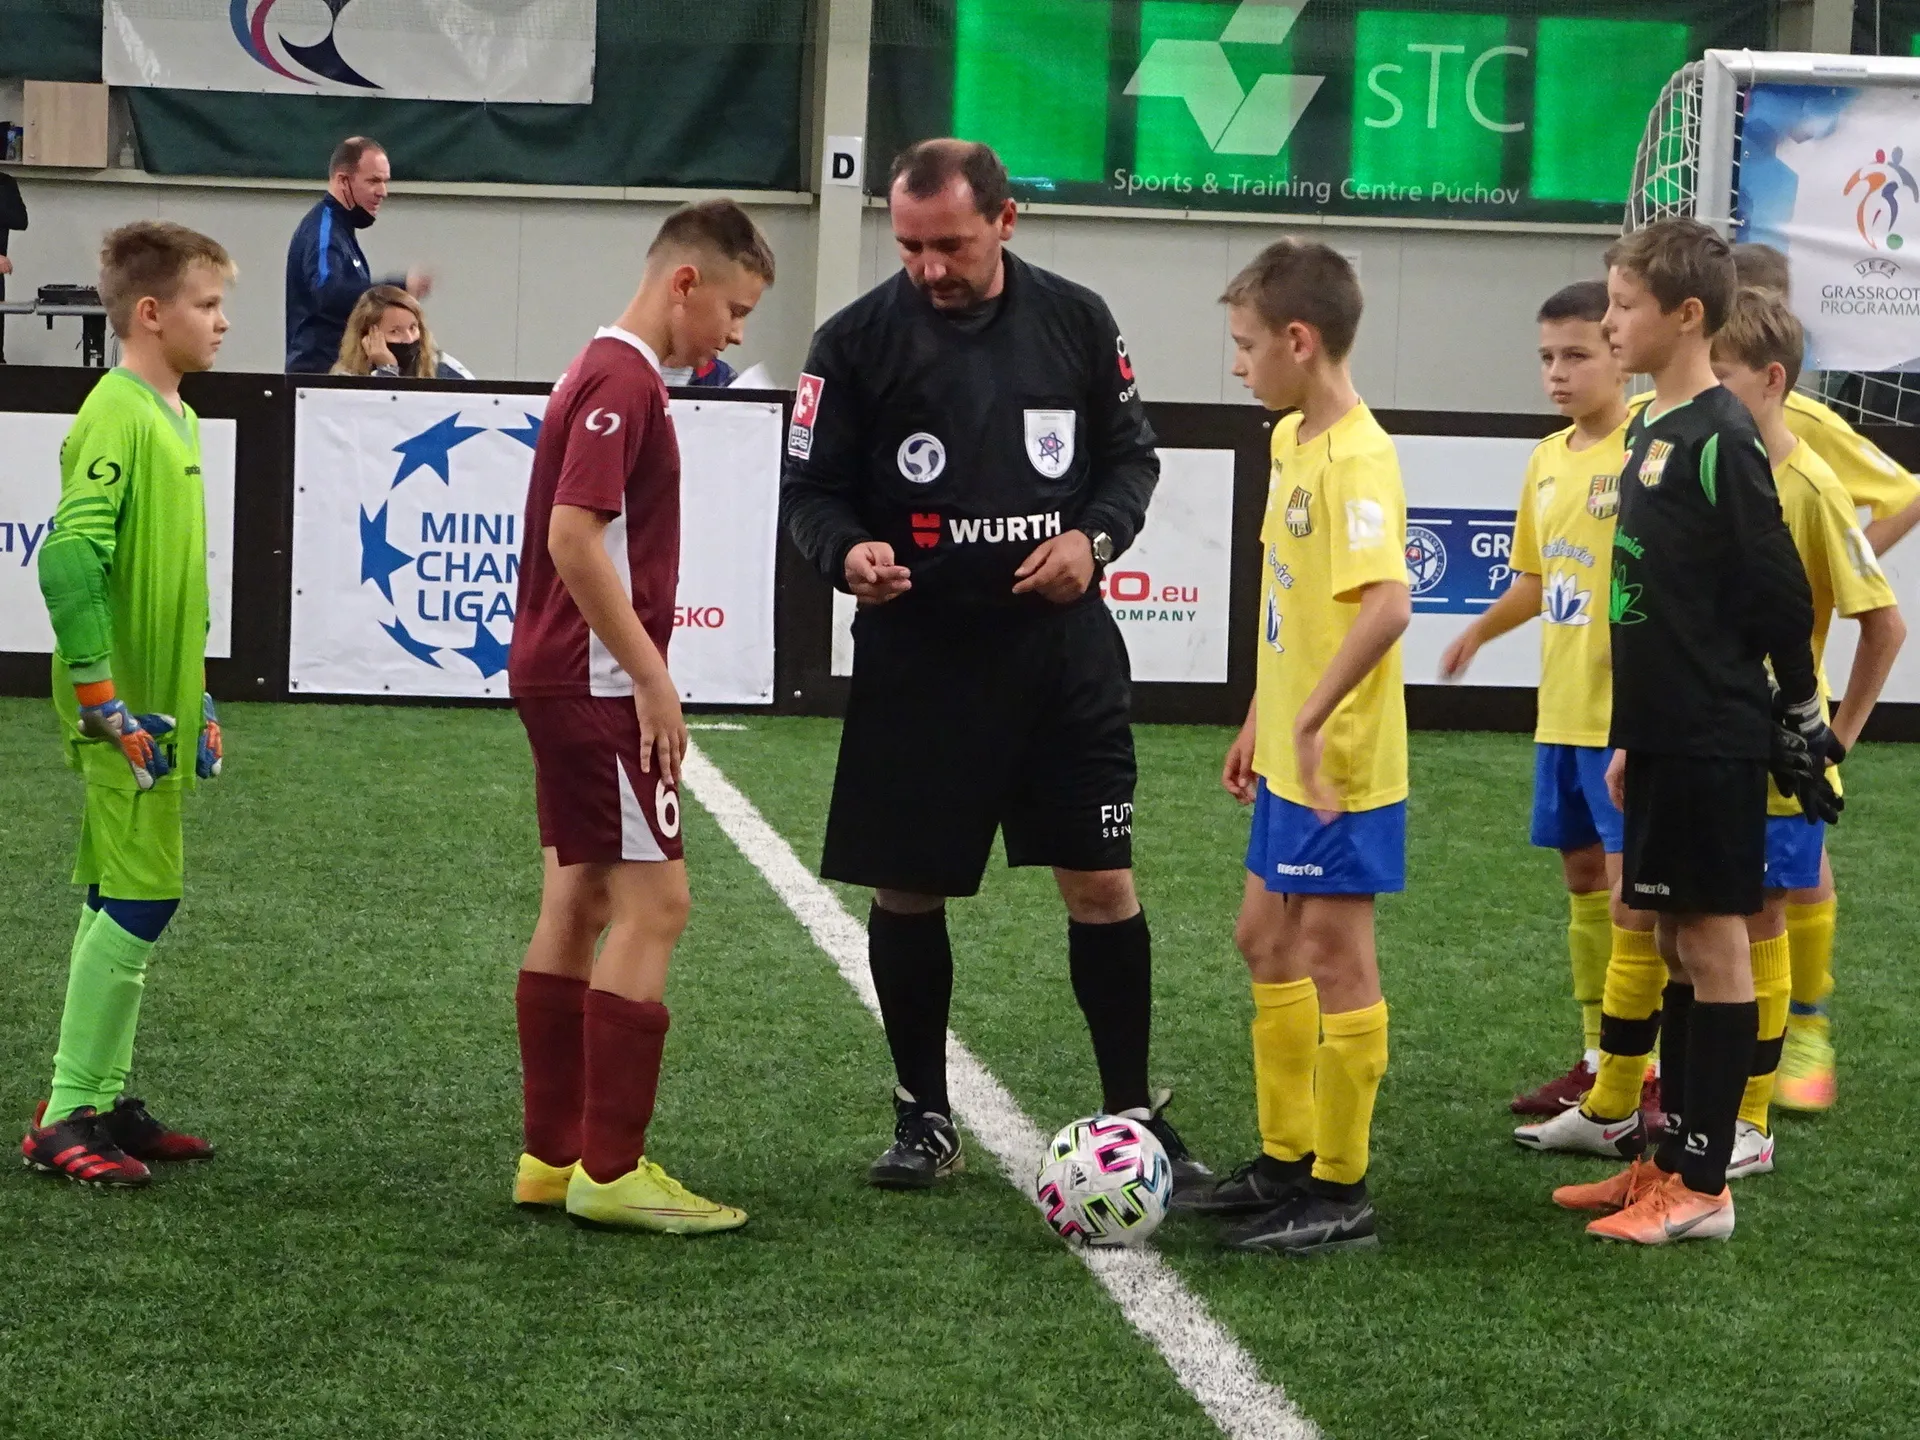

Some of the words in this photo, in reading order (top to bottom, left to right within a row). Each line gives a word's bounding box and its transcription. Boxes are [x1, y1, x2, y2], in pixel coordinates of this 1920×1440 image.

[832, 152, 855, 179] D
[1113, 168, 1193, 196] Sports
[1202, 172, 1219, 194] &
[1228, 173, 1331, 204] Training
[1340, 178, 1423, 202] Centre
[1431, 181, 1520, 204] Púchov
[1855, 260, 1897, 276] UEFA
[421, 512, 515, 544] MINI
[949, 511, 1061, 544] WÜRTH
[1100, 571, 1198, 602] O.eu
[417, 589, 514, 623] LIGA
[1110, 609, 1196, 621] OMPANY
[655, 779, 680, 838] 6
